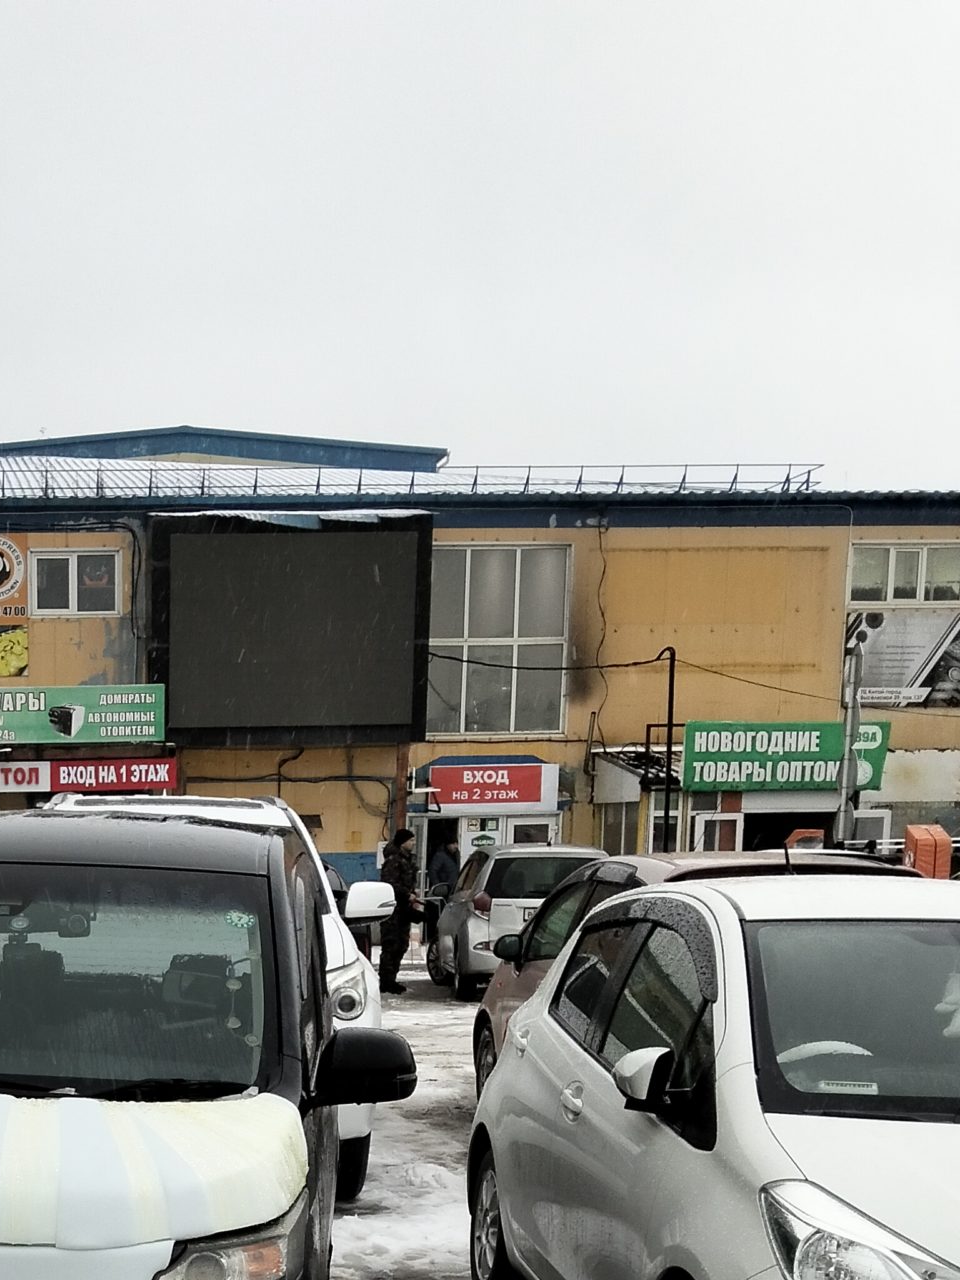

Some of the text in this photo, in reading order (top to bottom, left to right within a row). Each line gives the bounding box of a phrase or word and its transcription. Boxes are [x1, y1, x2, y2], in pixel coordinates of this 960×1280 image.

[2, 606, 12, 617] 47
[13, 606, 27, 617] 00
[99, 693, 156, 706] ДОМКРАТЫ
[88, 711, 156, 723] АВТОНОМНЫЕ
[100, 726, 156, 737] ОТОПИТЕЛИ
[694, 731, 821, 756] НОВОГОДНИЕ
[59, 763, 170, 787] ВХОД НА 1 ЭТАЖ
[462, 770, 510, 786] ВХОД
[693, 761, 772, 783] ТОВАРЫ
[452, 788, 519, 800] на 2 этаж
